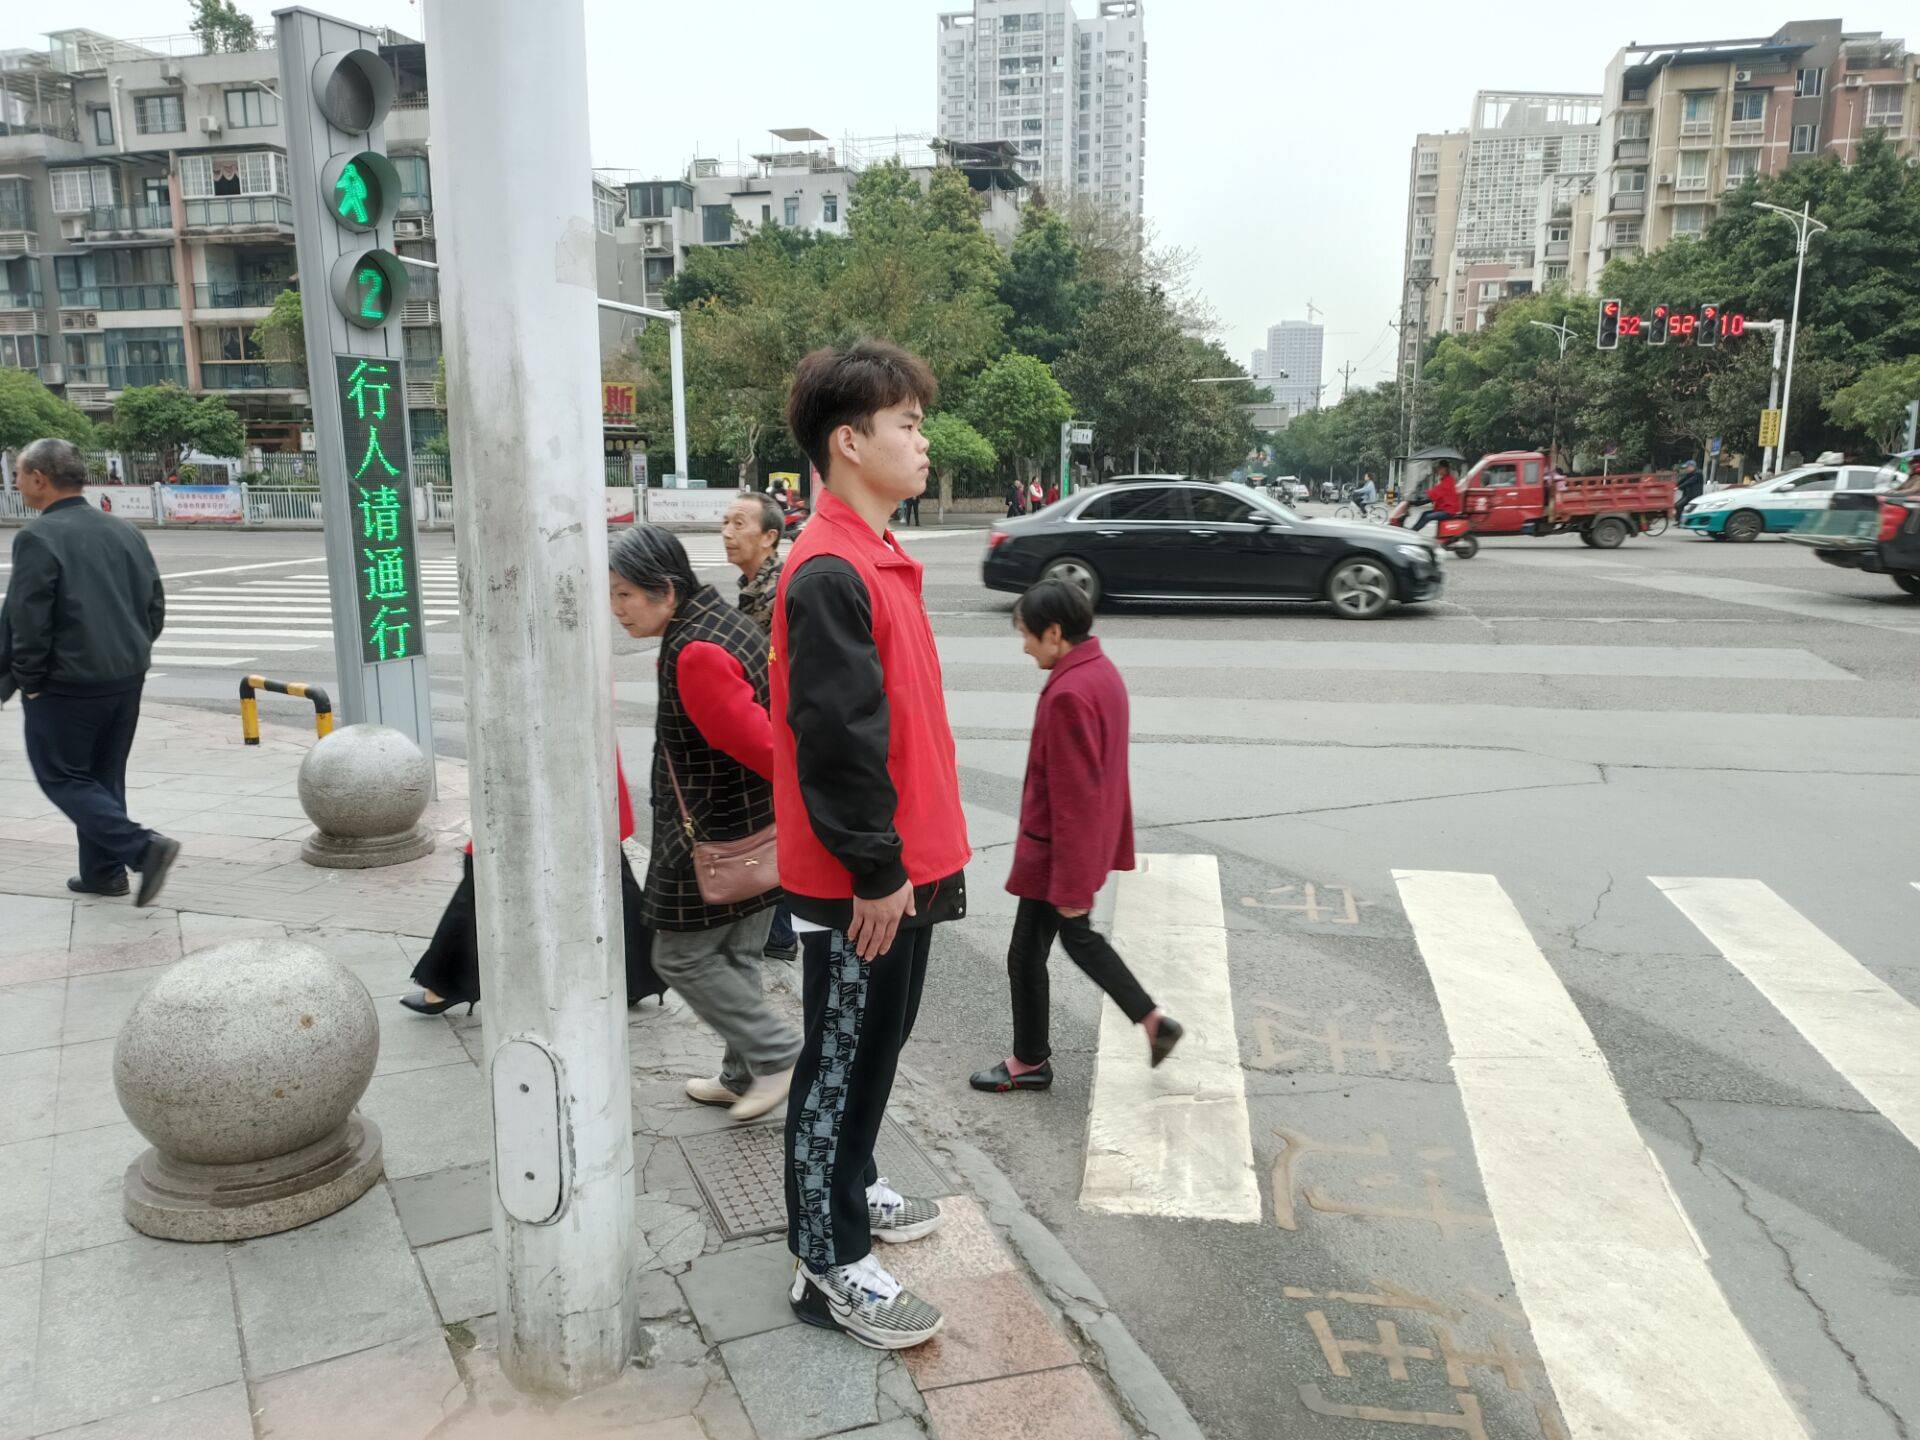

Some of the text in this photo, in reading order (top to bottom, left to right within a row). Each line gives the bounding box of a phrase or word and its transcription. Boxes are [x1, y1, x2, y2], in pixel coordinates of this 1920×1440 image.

[358, 268, 384, 319] 2
[1619, 316, 1641, 334] 52
[1669, 315, 1694, 334] 52
[1721, 315, 1743, 335] 10
[347, 359, 410, 661] 行人请通行
